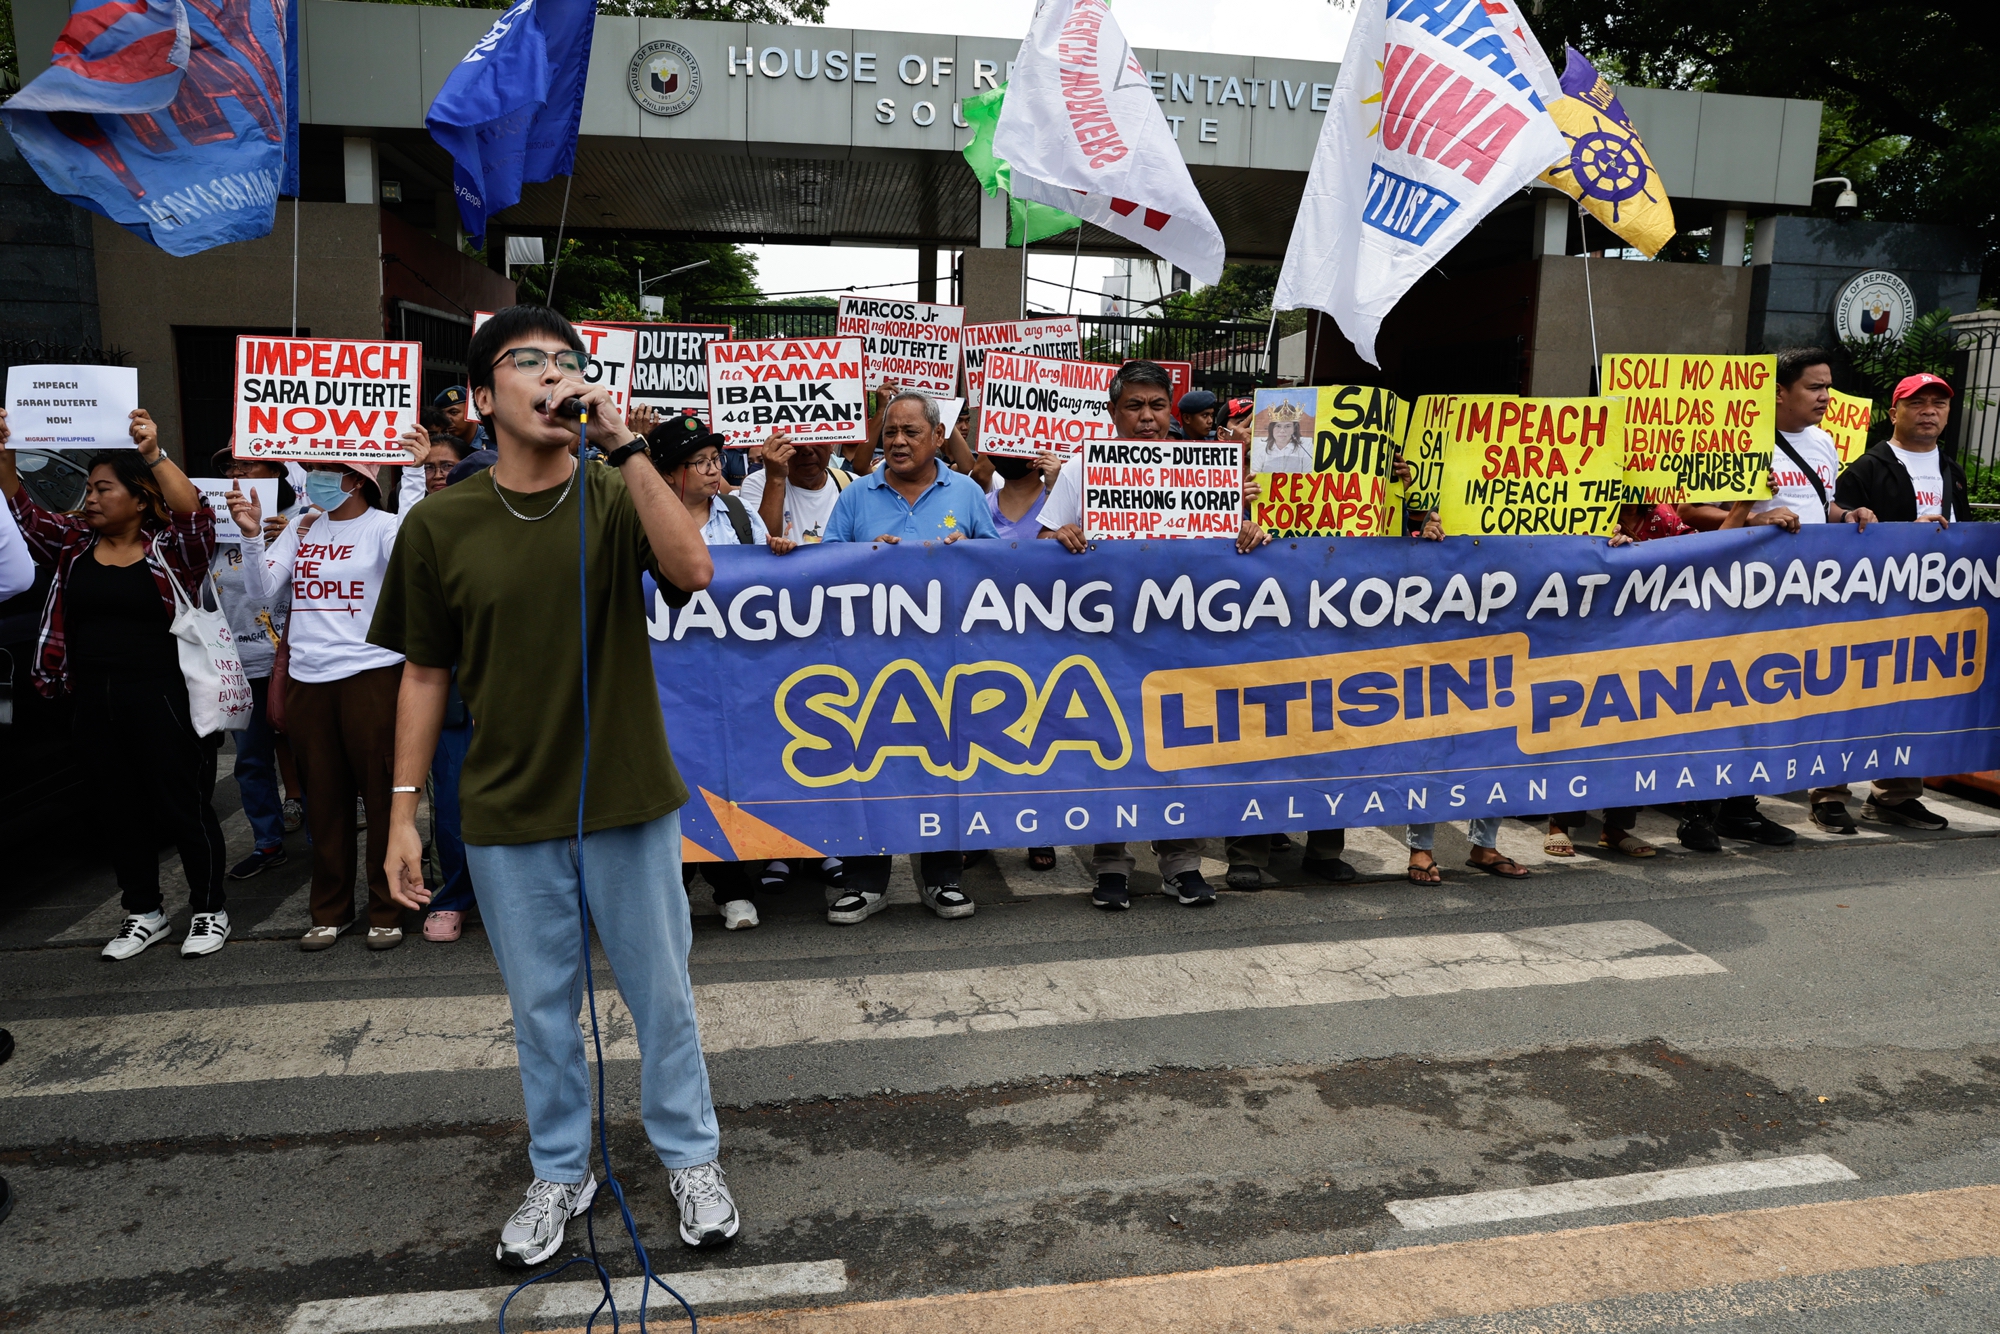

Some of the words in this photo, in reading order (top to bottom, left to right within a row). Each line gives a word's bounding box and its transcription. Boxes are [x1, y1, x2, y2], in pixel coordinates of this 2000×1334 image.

[631, 61, 641, 92] HOUSE
[637, 49, 647, 61] OF
[648, 42, 699, 96] REPRESENTATIVES
[727, 45, 879, 84] HOUSE
[898, 53, 953, 86] OF
[642, 98, 687, 112] PHILIPPINES
[876, 97, 969, 129] SOU
[1382, 43, 1530, 186] UNA
[459, 187, 482, 208] People
[1365, 170, 1450, 238] TYLIST
[921, 306, 939, 322] Jr
[1839, 295, 1851, 330] HOUSE
[1850, 282, 1861, 294] OF
[839, 317, 870, 335] HARI
[871, 321, 885, 334] ng
[884, 321, 960, 343] KORAPSYON
[964, 324, 1022, 346] ITAKWIL
[1024, 326, 1043, 340] ang
[1045, 324, 1073, 338] mga
[246, 341, 409, 380] IMPEACH
[714, 341, 842, 363] NAKAW
[880, 338, 948, 361] DUTERTE
[720, 369, 743, 381] na
[742, 362, 860, 383] YAMAN
[870, 359, 882, 371] ng
[882, 358, 955, 380] KORAPSYON!
[987, 354, 1041, 384] IBALIK
[1040, 367, 1060, 384] ang
[1609, 357, 1669, 391] ISOLI
[1681, 359, 1714, 390] MO
[1720, 360, 1770, 391] ANG
[33, 381, 78, 389] IMPEACH
[244, 378, 310, 405] SARA
[314, 381, 411, 408] DUTERTE
[717, 383, 835, 405] IBALIK
[883, 375, 950, 391] HEAD
[17, 399, 50, 407] SARAH
[53, 399, 98, 407] DUTERTE
[986, 382, 1058, 412] IKULONG
[1059, 395, 1082, 416] ang
[1625, 396, 1715, 426] INALDAS
[1724, 399, 1760, 427] NG
[46, 416, 72, 424] NOW!
[249, 405, 399, 440] NOW!
[722, 410, 750, 422] sa
[752, 403, 863, 425] BAYAN!
[1456, 401, 1609, 447] IMPEACH
[1825, 397, 1871, 432] SARA
[771, 422, 856, 435] HEAD
[1624, 428, 1686, 453] IBING
[1691, 429, 1753, 453] ISANG
[310, 438, 404, 451] HEAD
[1034, 440, 1083, 453] HEA
[1088, 444, 1239, 466] MARCOS-DUTERTE
[1481, 445, 1594, 481] SARA!
[1087, 466, 1155, 487] WALANG
[1269, 472, 1362, 503] REYNA
[1676, 471, 1757, 495] FUNDS!
[1087, 488, 1176, 510] PAREHONG
[1181, 490, 1240, 511] KORAP
[1465, 479, 1568, 505] IMPEACH
[1579, 480, 1623, 502] THE
[1087, 511, 1162, 531] PAHIRAP
[1164, 517, 1187, 528] sa
[1187, 513, 1239, 533] MASA!
[1481, 501, 1621, 534] CORRUPT!
[646, 578, 942, 642] NAGUTIN
[960, 578, 1114, 635] ANG
[1132, 574, 1292, 635] MGA
[1308, 570, 1517, 629] KORAP
[1526, 572, 1611, 620] AT
[1614, 552, 2000, 617] MANDARAMBON
[773, 654, 1133, 788] SARA
[1159, 654, 1514, 749] LITISIN!
[1530, 629, 1978, 734] PANAGUTIN!
[920, 801, 1187, 837] BAGONG
[1241, 775, 1589, 823] ALYANSANG
[1634, 745, 1912, 791] MAKABAYAN
